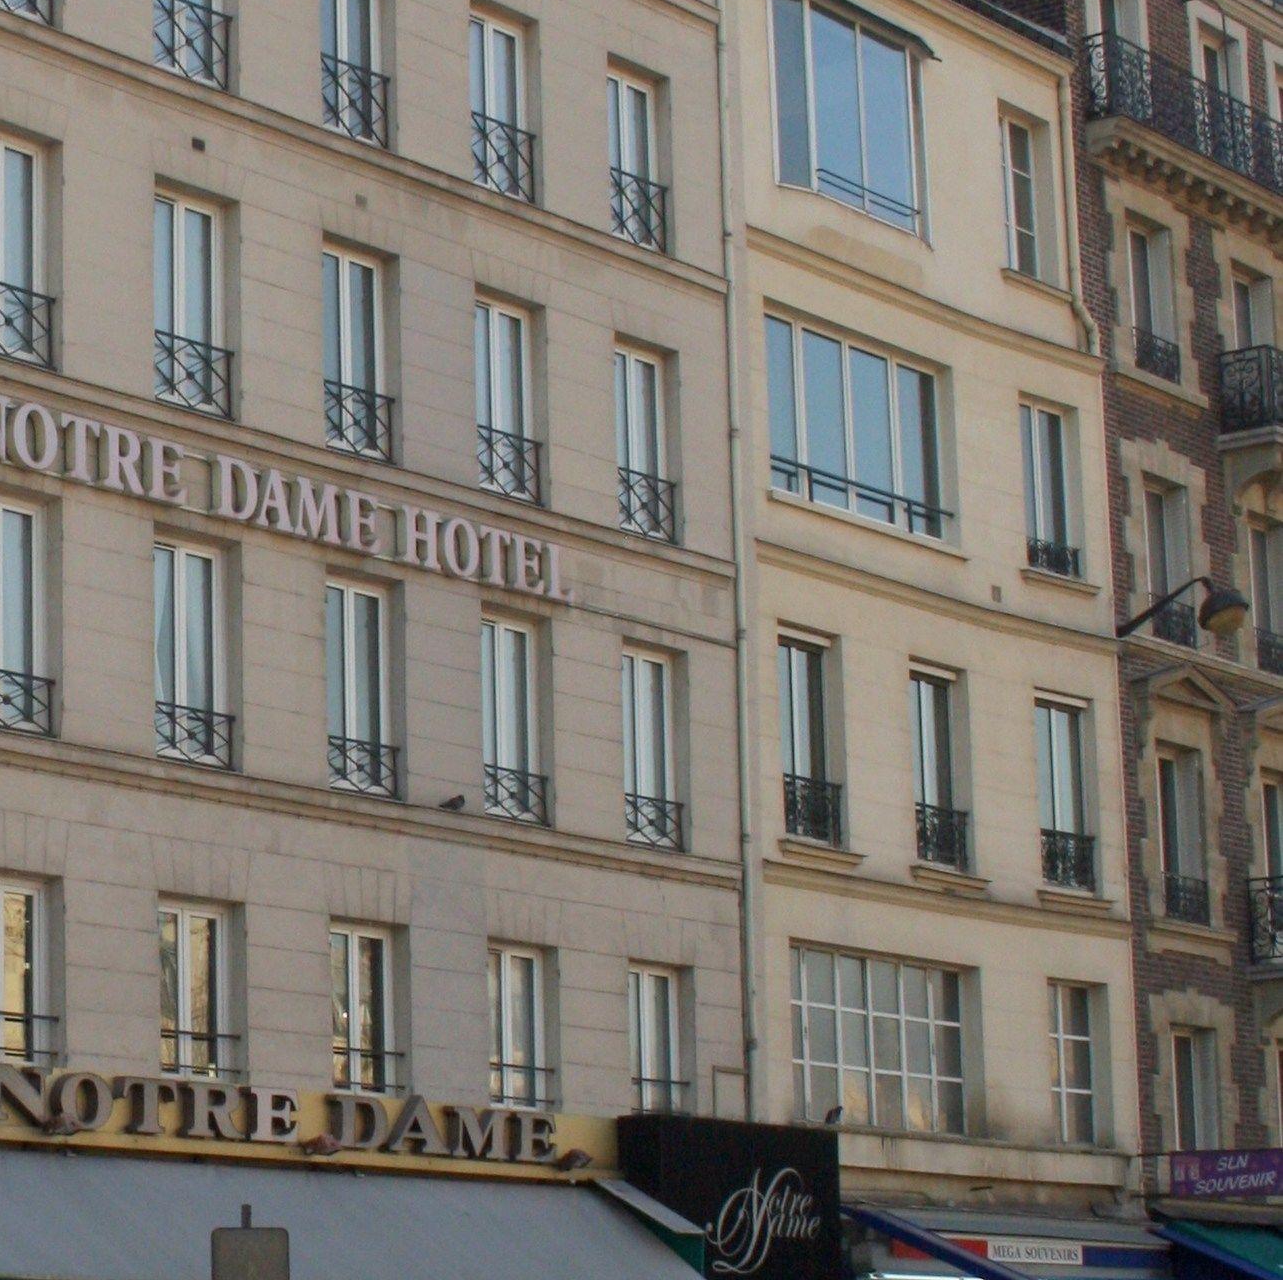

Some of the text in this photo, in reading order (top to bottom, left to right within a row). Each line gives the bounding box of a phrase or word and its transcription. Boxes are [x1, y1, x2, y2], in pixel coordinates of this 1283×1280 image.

[216, 456, 382, 557] DAME
[401, 504, 578, 602] HOTEL
[324, 1094, 559, 1163] DAME
[1217, 1154, 1248, 1171] SLN
[1194, 1170, 1277, 1195] SOUVENIR
[993, 1245, 1078, 1261] MEGA SOUVENIRS
